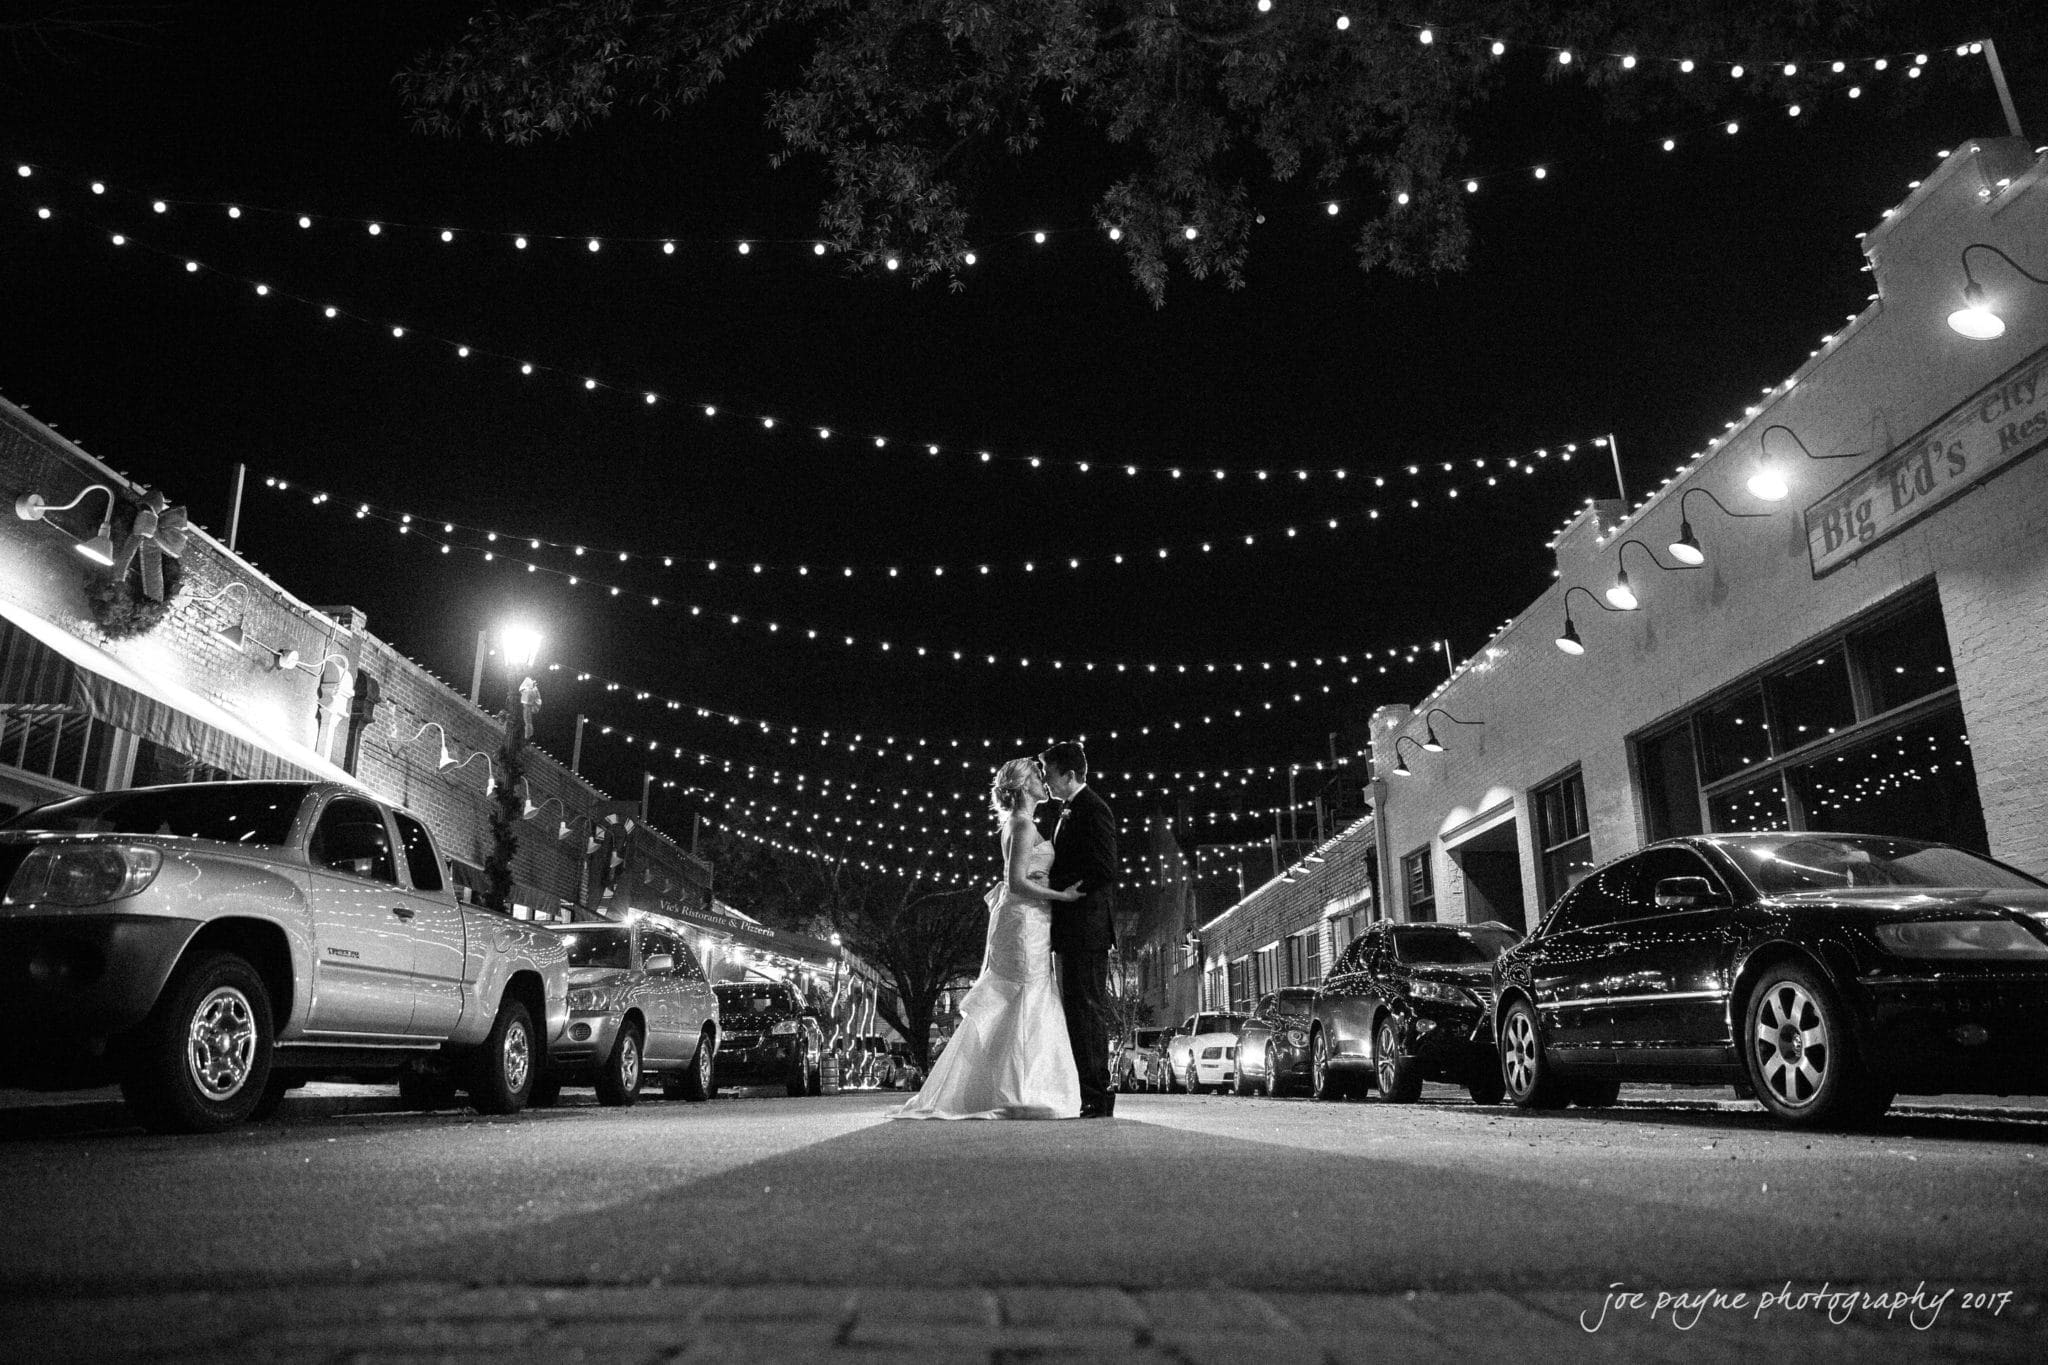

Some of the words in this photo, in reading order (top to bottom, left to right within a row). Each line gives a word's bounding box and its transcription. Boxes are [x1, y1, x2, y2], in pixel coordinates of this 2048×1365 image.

[1822, 499, 1877, 557] Big
[1884, 439, 1967, 516] Ed's
[660, 900, 679, 913] Vic's
[681, 905, 726, 926] Ristorante
[728, 918, 738, 928] &
[741, 920, 775, 938] Pizzeria
